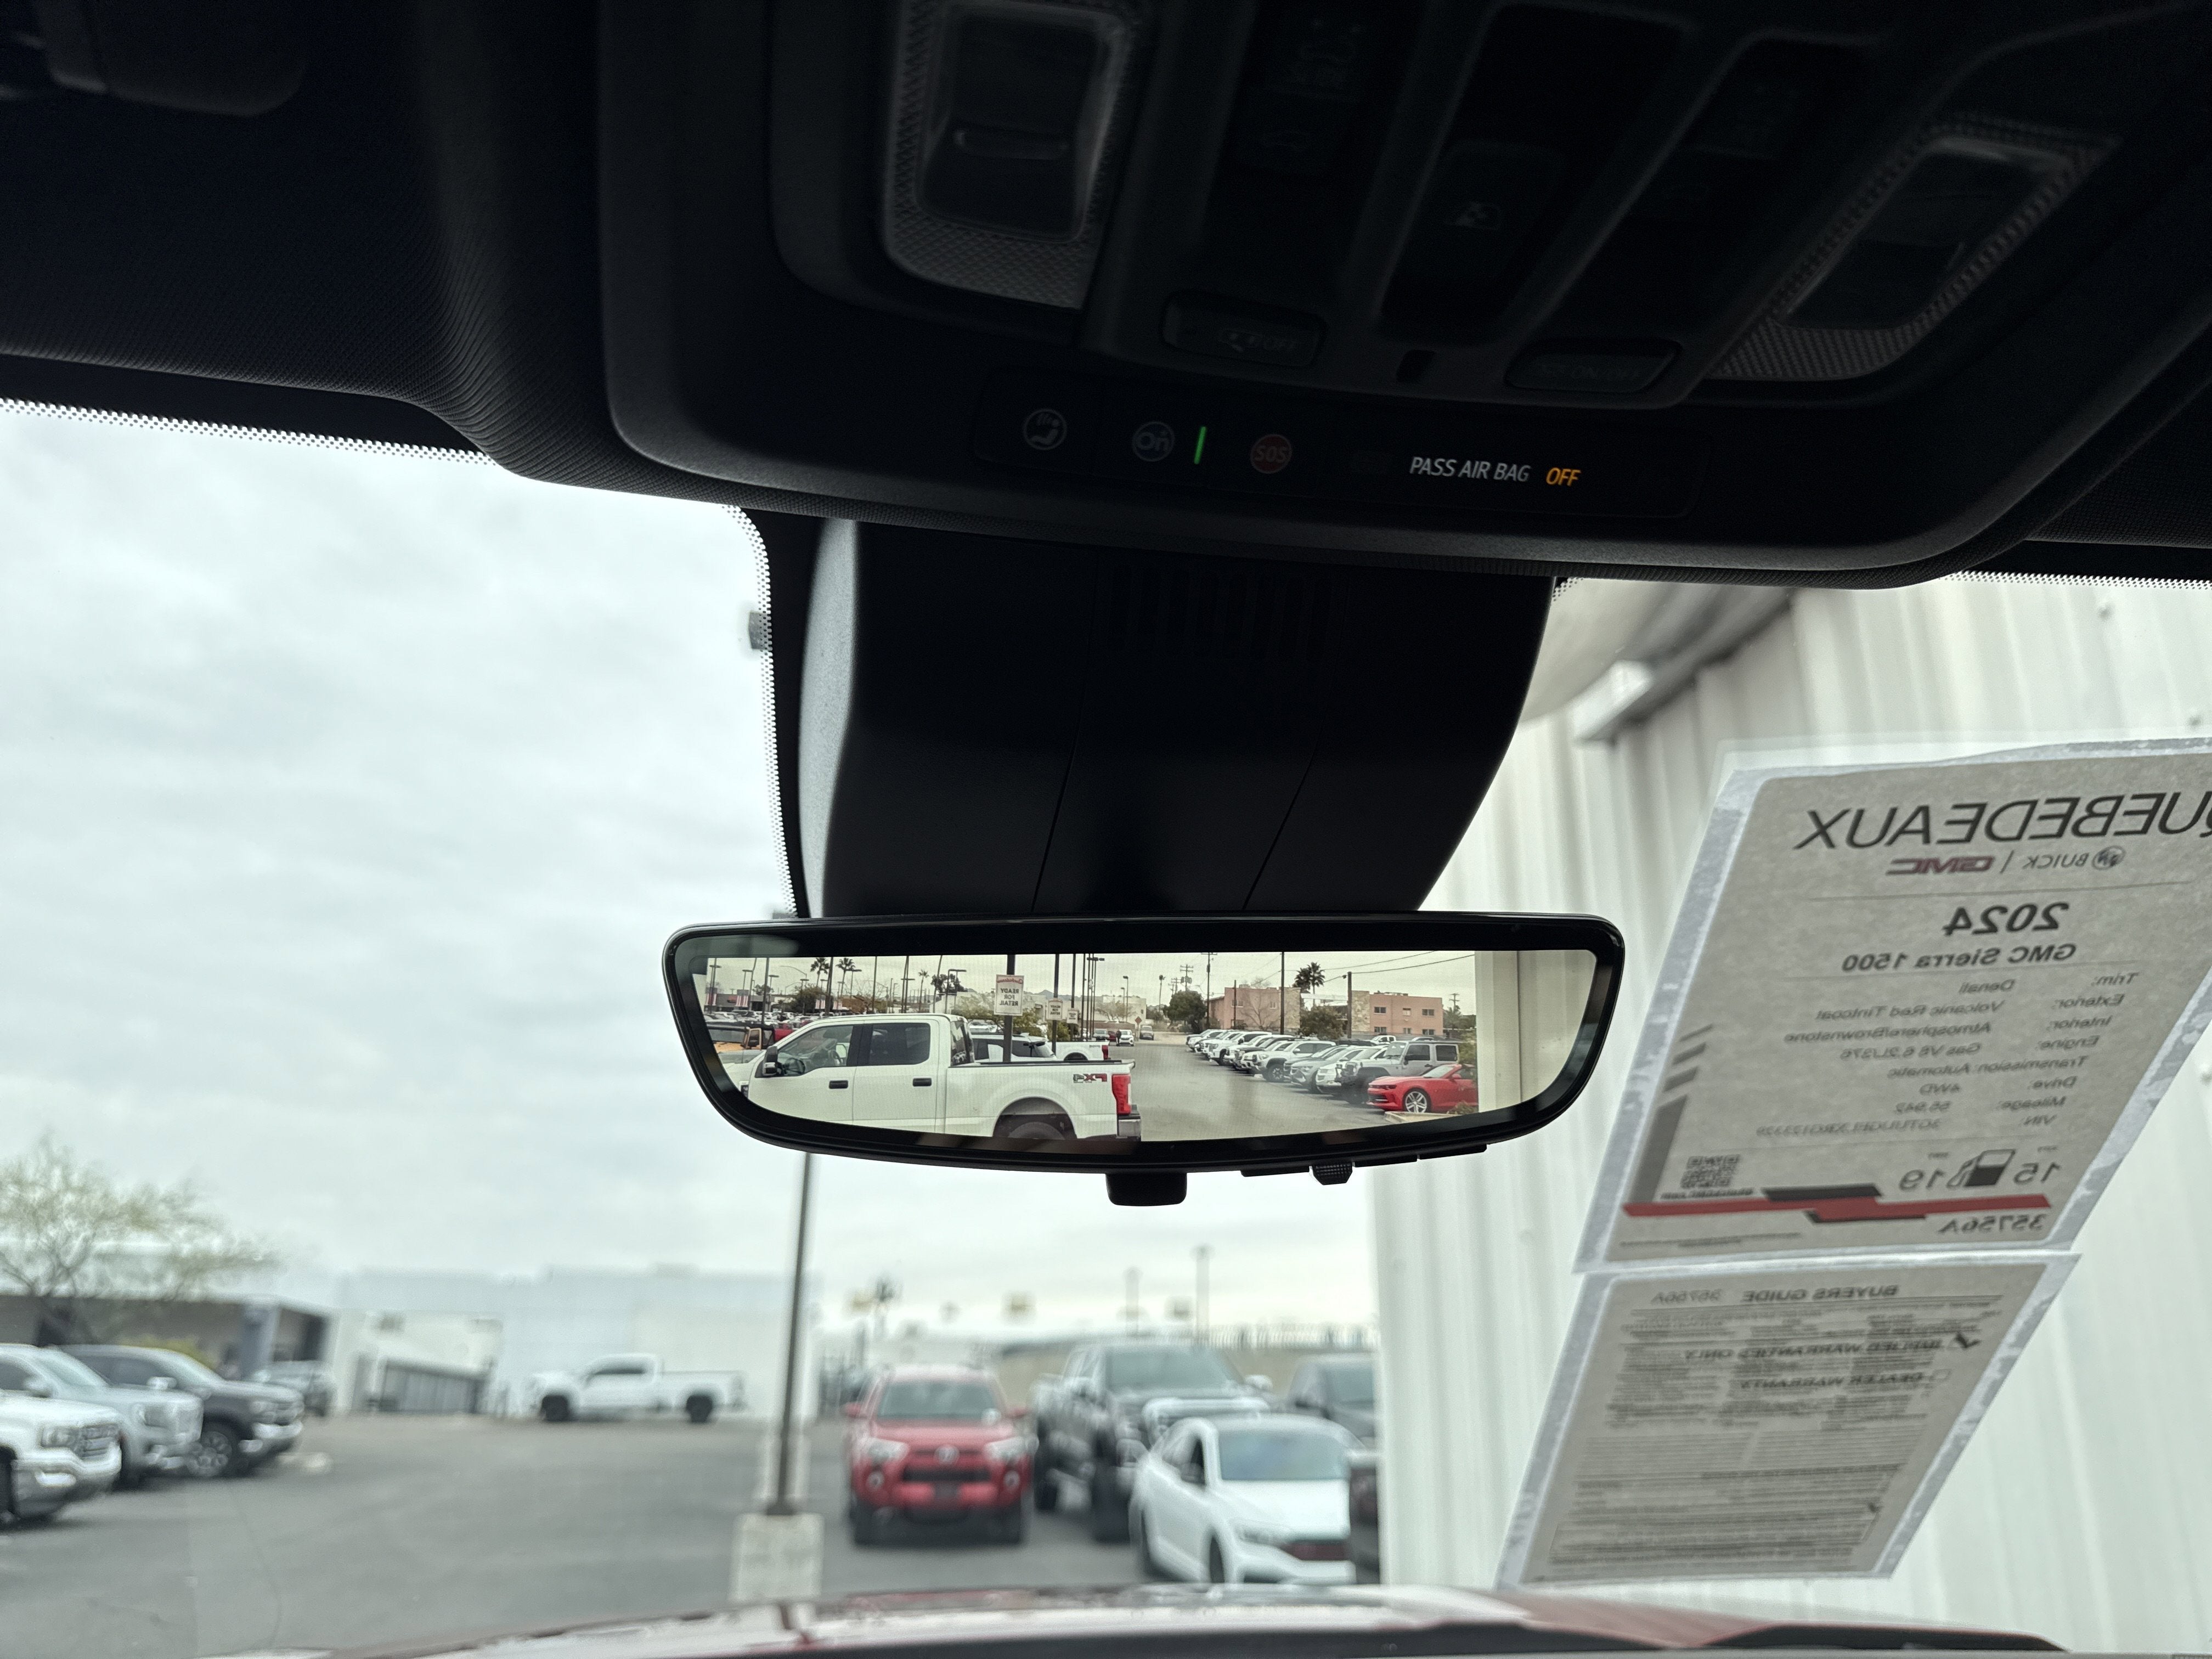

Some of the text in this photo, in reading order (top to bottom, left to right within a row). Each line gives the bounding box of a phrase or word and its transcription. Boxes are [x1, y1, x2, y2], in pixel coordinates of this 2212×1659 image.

[1254, 445, 1289, 464] SOS
[1409, 456, 1582, 487] PASS AIR BAG OFF
